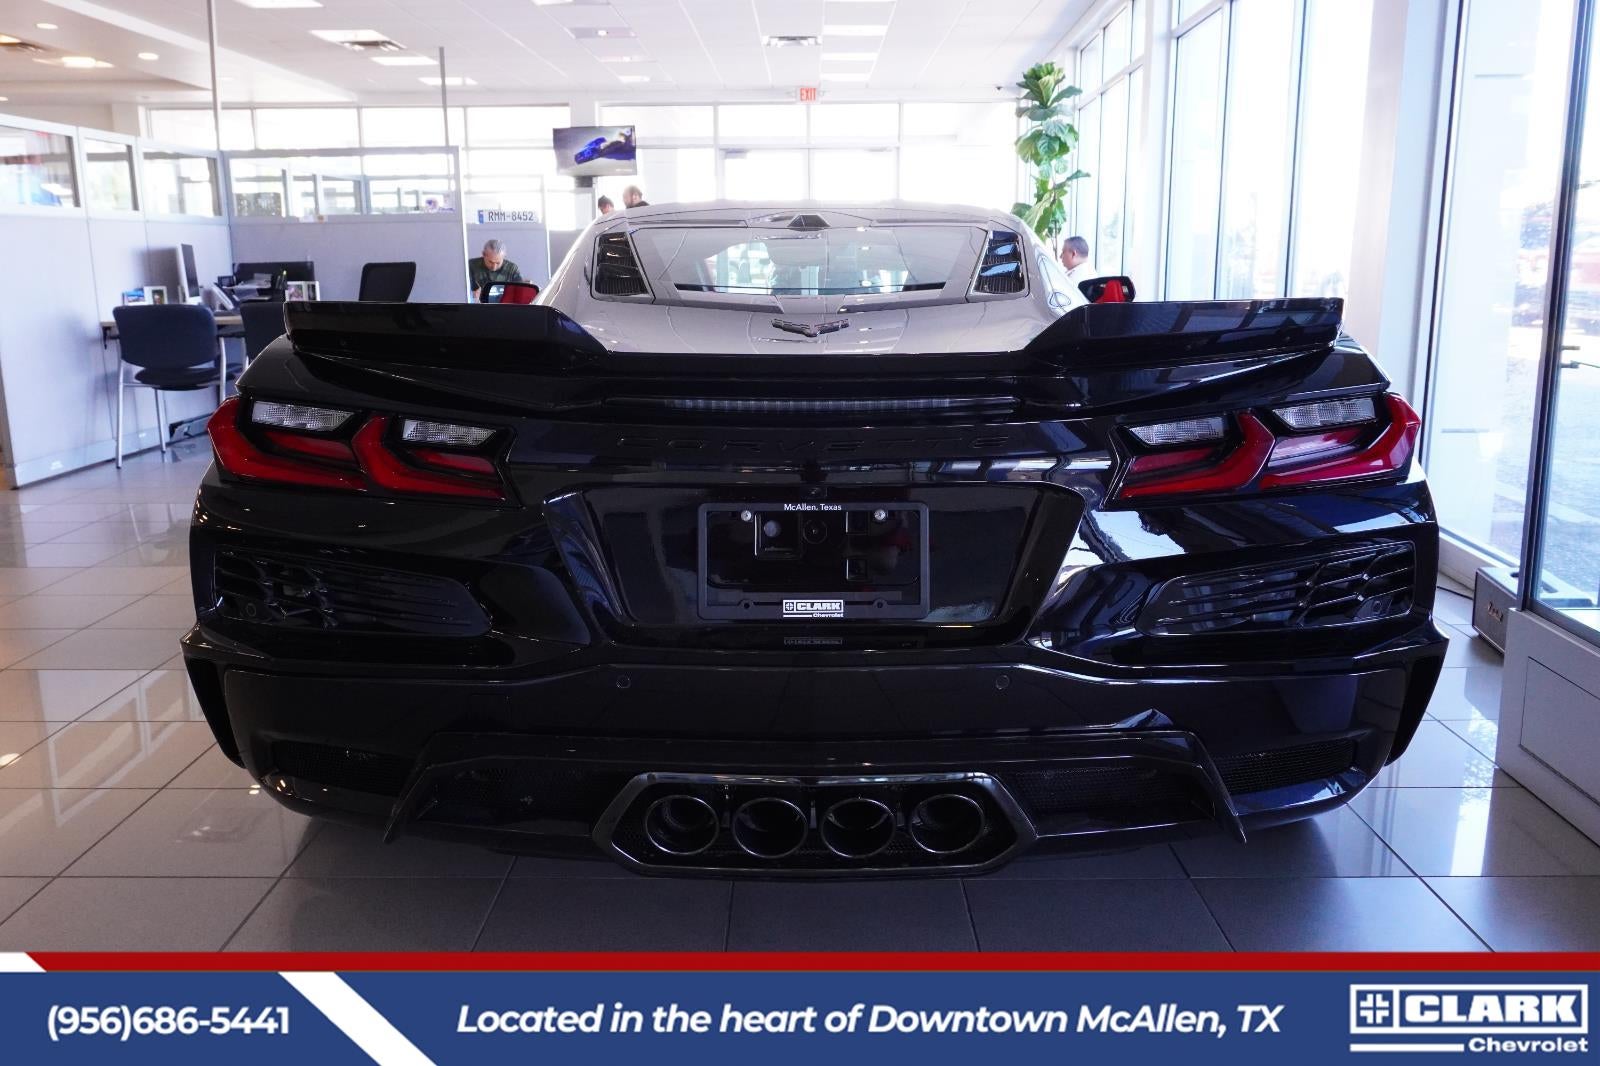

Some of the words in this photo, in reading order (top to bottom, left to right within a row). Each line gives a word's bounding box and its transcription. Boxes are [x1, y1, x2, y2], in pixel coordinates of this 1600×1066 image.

[800, 87, 817, 102] EXIT
[488, 211, 534, 222] RMM-8452
[616, 435, 1010, 453] CORVETTE
[820, 503, 842, 511] Texas
[796, 602, 841, 611] CLARK
